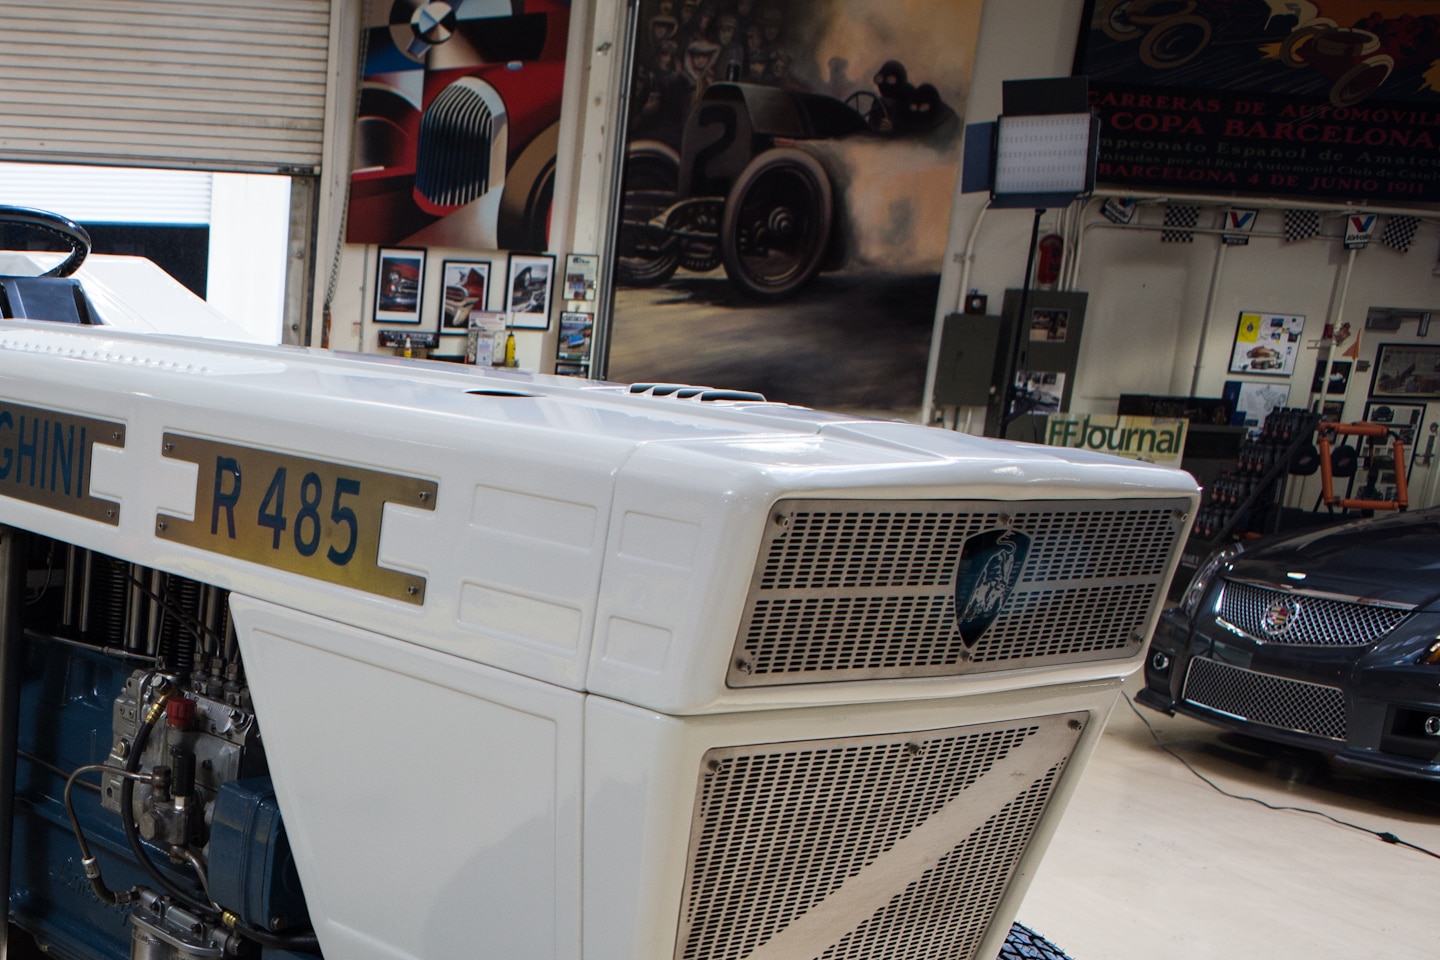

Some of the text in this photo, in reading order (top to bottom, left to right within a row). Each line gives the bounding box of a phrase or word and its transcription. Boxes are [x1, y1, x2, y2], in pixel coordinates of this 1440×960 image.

[1088, 90, 1221, 112] CARRERAS
[1234, 100, 1267, 116] DE
[1110, 111, 1435, 149] COPA BARCELONA
[1101, 138, 1207, 153] mpeonato
[1318, 149, 1344, 162] de
[1098, 162, 1424, 195] BARCELONA 4 DE JUNIO 1911
[1049, 415, 1184, 454] FFJournal
[210, 455, 361, 567] R 485
